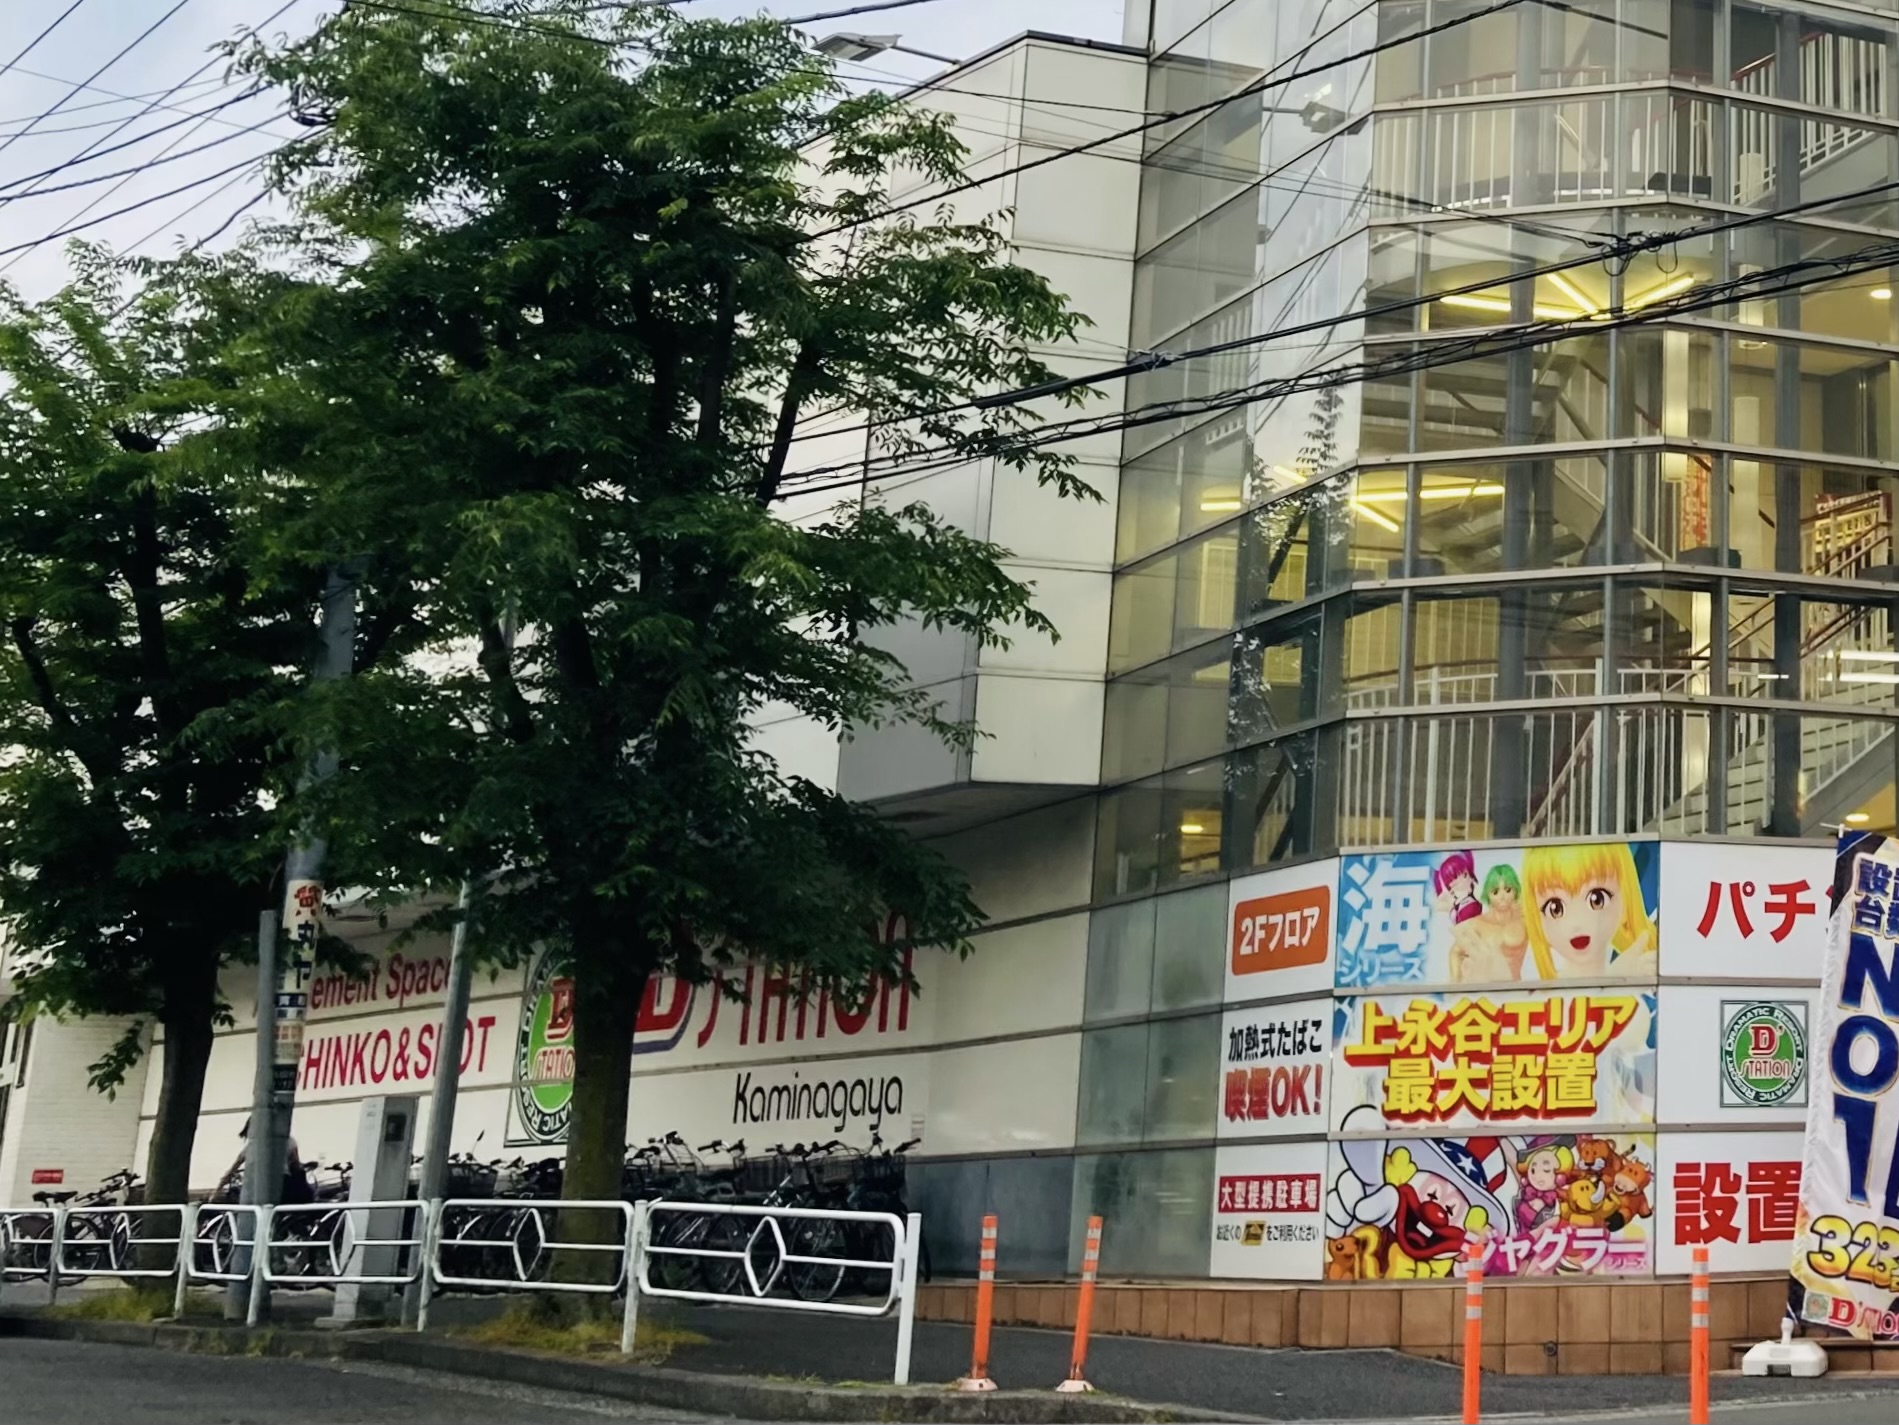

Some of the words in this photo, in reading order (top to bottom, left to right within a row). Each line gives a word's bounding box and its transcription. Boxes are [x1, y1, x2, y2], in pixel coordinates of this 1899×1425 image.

[1239, 906, 1321, 956] 2Fフロア
[1342, 857, 1432, 956] 海
[1227, 1018, 1323, 1063] 加熱式たばこ
[1344, 994, 1640, 1064] 上永谷エリア
[1725, 1007, 1770, 1052] DRAMATIC
[1772, 1008, 1803, 1053] RESORT
[1382, 1052, 1599, 1118] 最大設置
[1738, 1058, 1791, 1079] STATION
[732, 1071, 904, 1134] Kaminagaya
[1220, 1178, 1318, 1210] 大型提携駐車場
